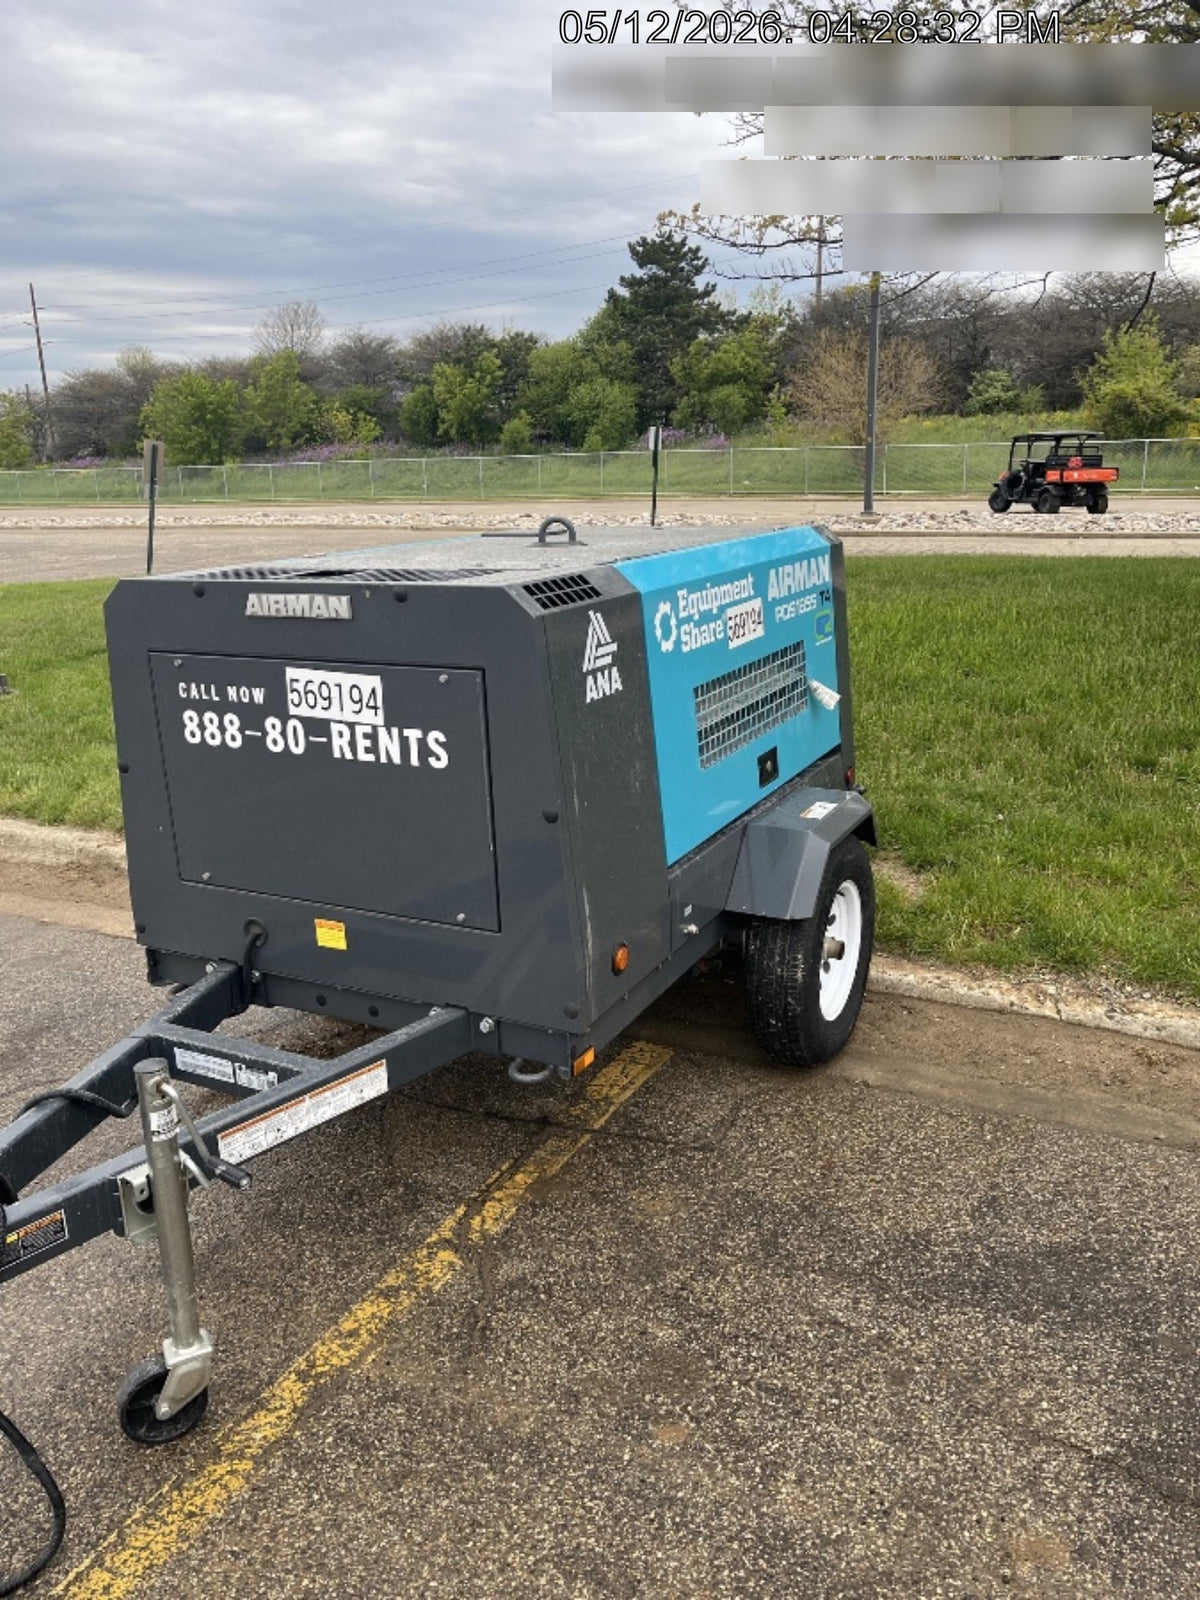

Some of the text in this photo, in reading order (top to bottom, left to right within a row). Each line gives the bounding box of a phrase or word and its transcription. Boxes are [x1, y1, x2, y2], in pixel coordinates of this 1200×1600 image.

[677, 572, 754, 619] Equipment
[768, 554, 829, 601] AIRMAN
[245, 593, 352, 619] AIRMAN
[680, 619, 724, 652] Share
[178, 681, 265, 705] CALL NOW
[289, 678, 381, 717] 569194
[586, 666, 623, 703] ANA
[182, 709, 449, 769] 888-80-RENTS
